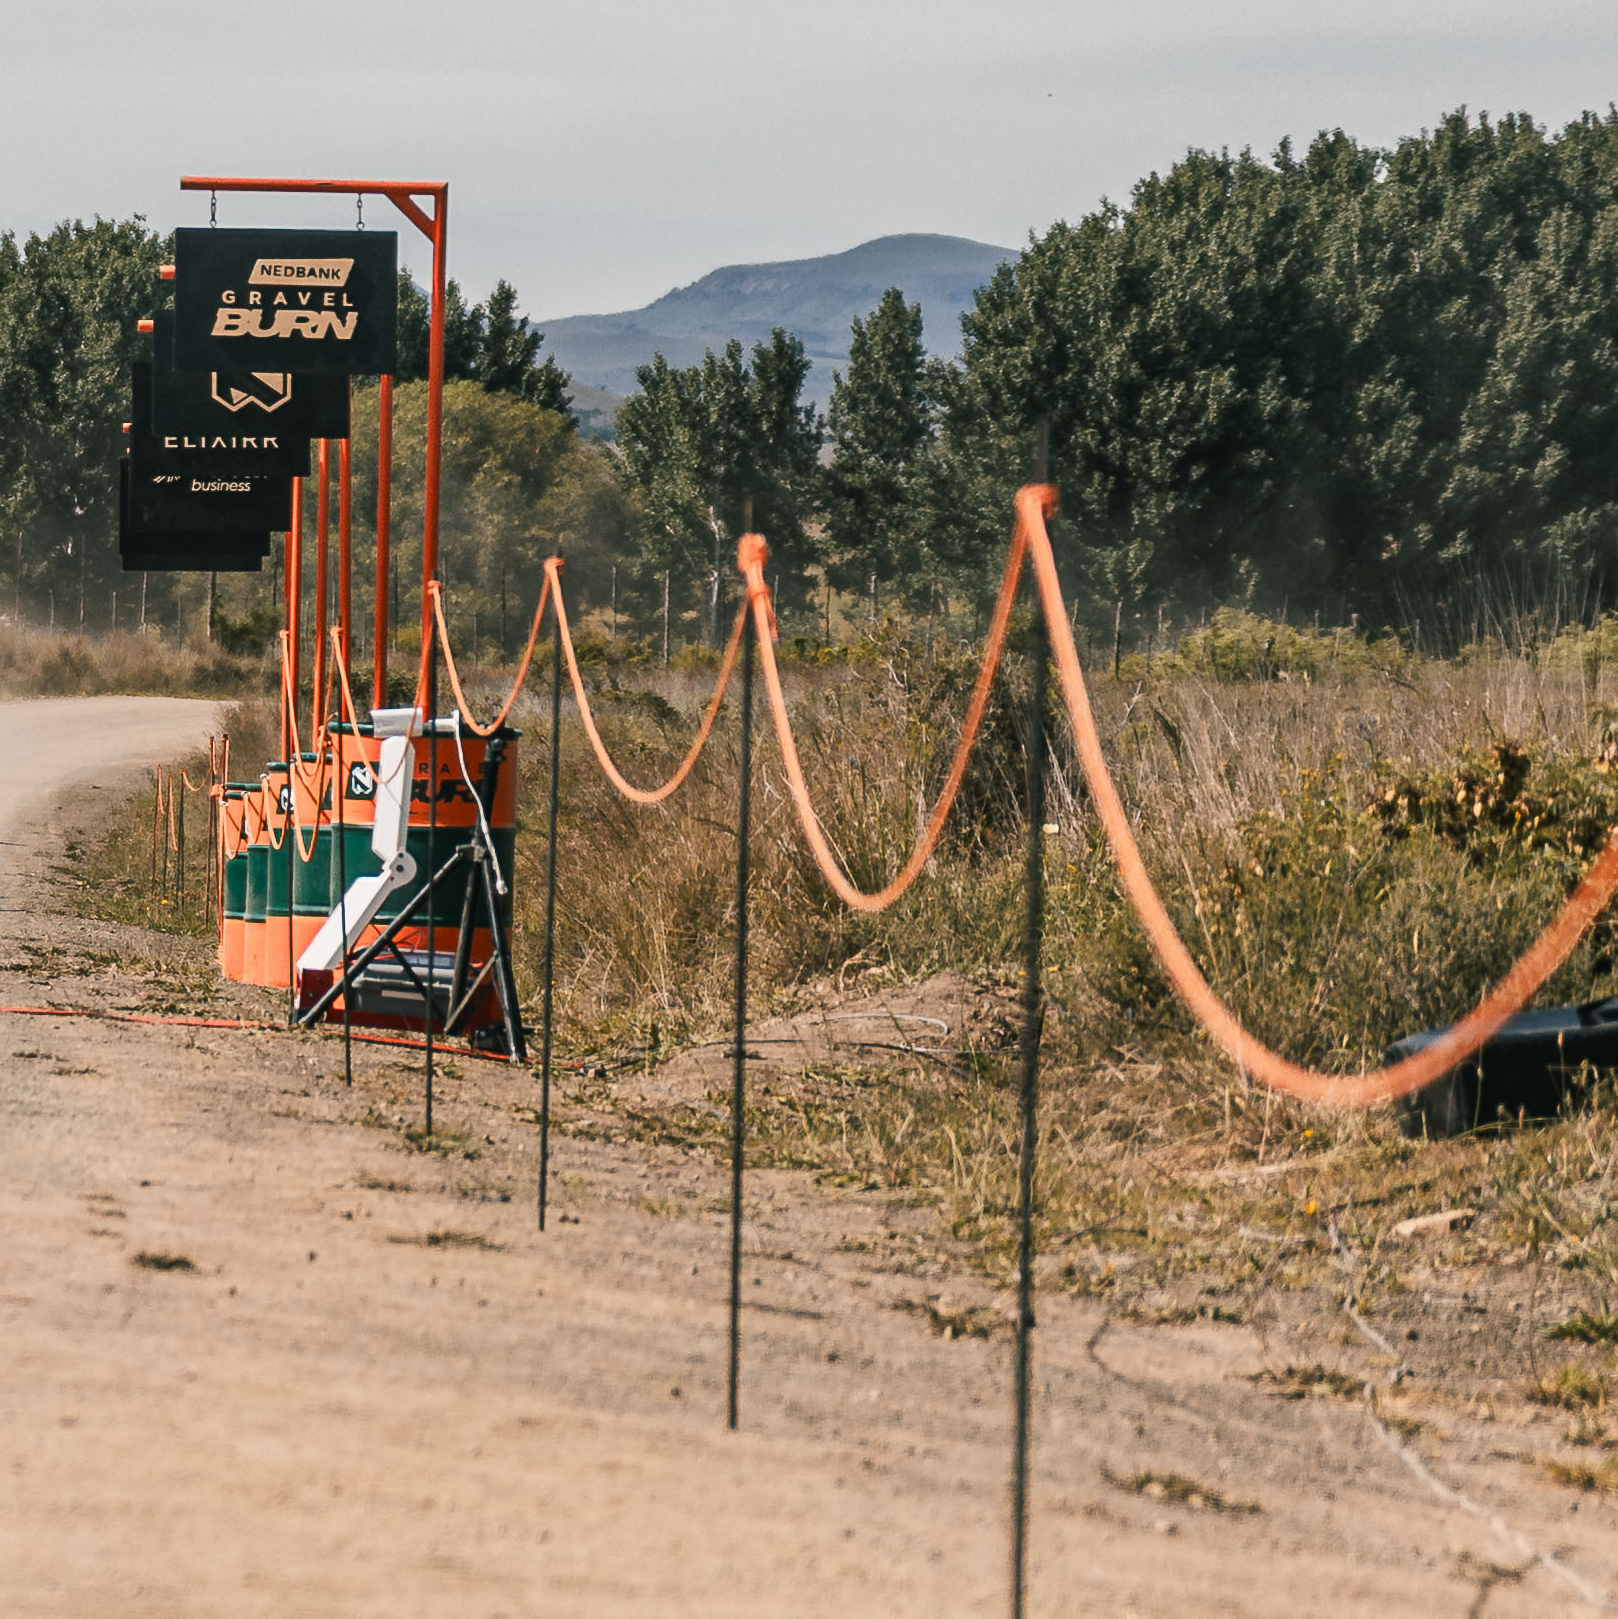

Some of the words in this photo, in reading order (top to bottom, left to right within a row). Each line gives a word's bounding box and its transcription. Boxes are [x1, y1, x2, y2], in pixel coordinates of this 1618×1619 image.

[260, 264, 341, 280] NEDBANK
[221, 289, 353, 307] GRAVEL
[211, 308, 358, 340] BURN
[191, 479, 251, 492] business
